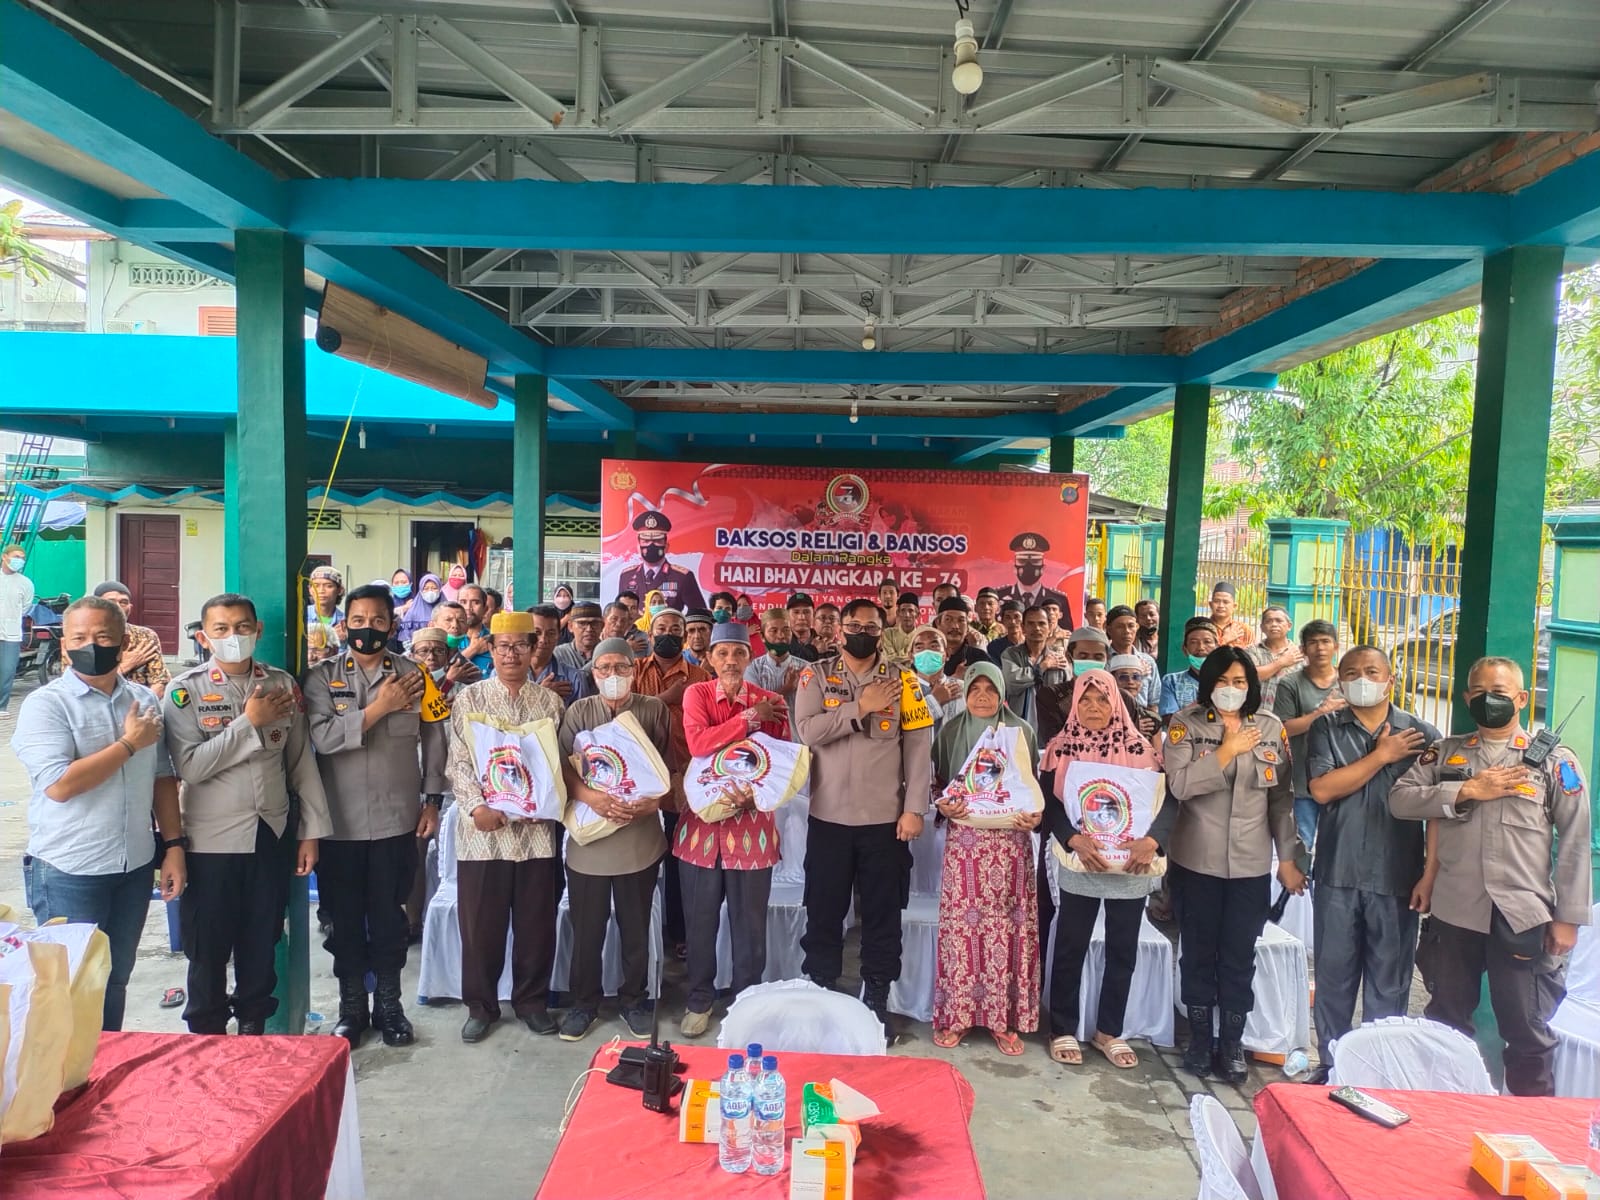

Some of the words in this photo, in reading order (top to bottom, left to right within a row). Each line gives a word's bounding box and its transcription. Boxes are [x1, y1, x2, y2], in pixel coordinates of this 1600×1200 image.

[717, 529, 798, 549] BAKSOS
[801, 532, 863, 551] RELIGI
[867, 533, 881, 551] &
[886, 533, 967, 554] BANSOS
[791, 551, 835, 562] Dalam
[839, 552, 892, 565] Rangka
[720, 566, 760, 583] HARI
[900, 571, 922, 588] KE
[939, 572, 961, 588] 76
[198, 704, 232, 713] RASIDIN
